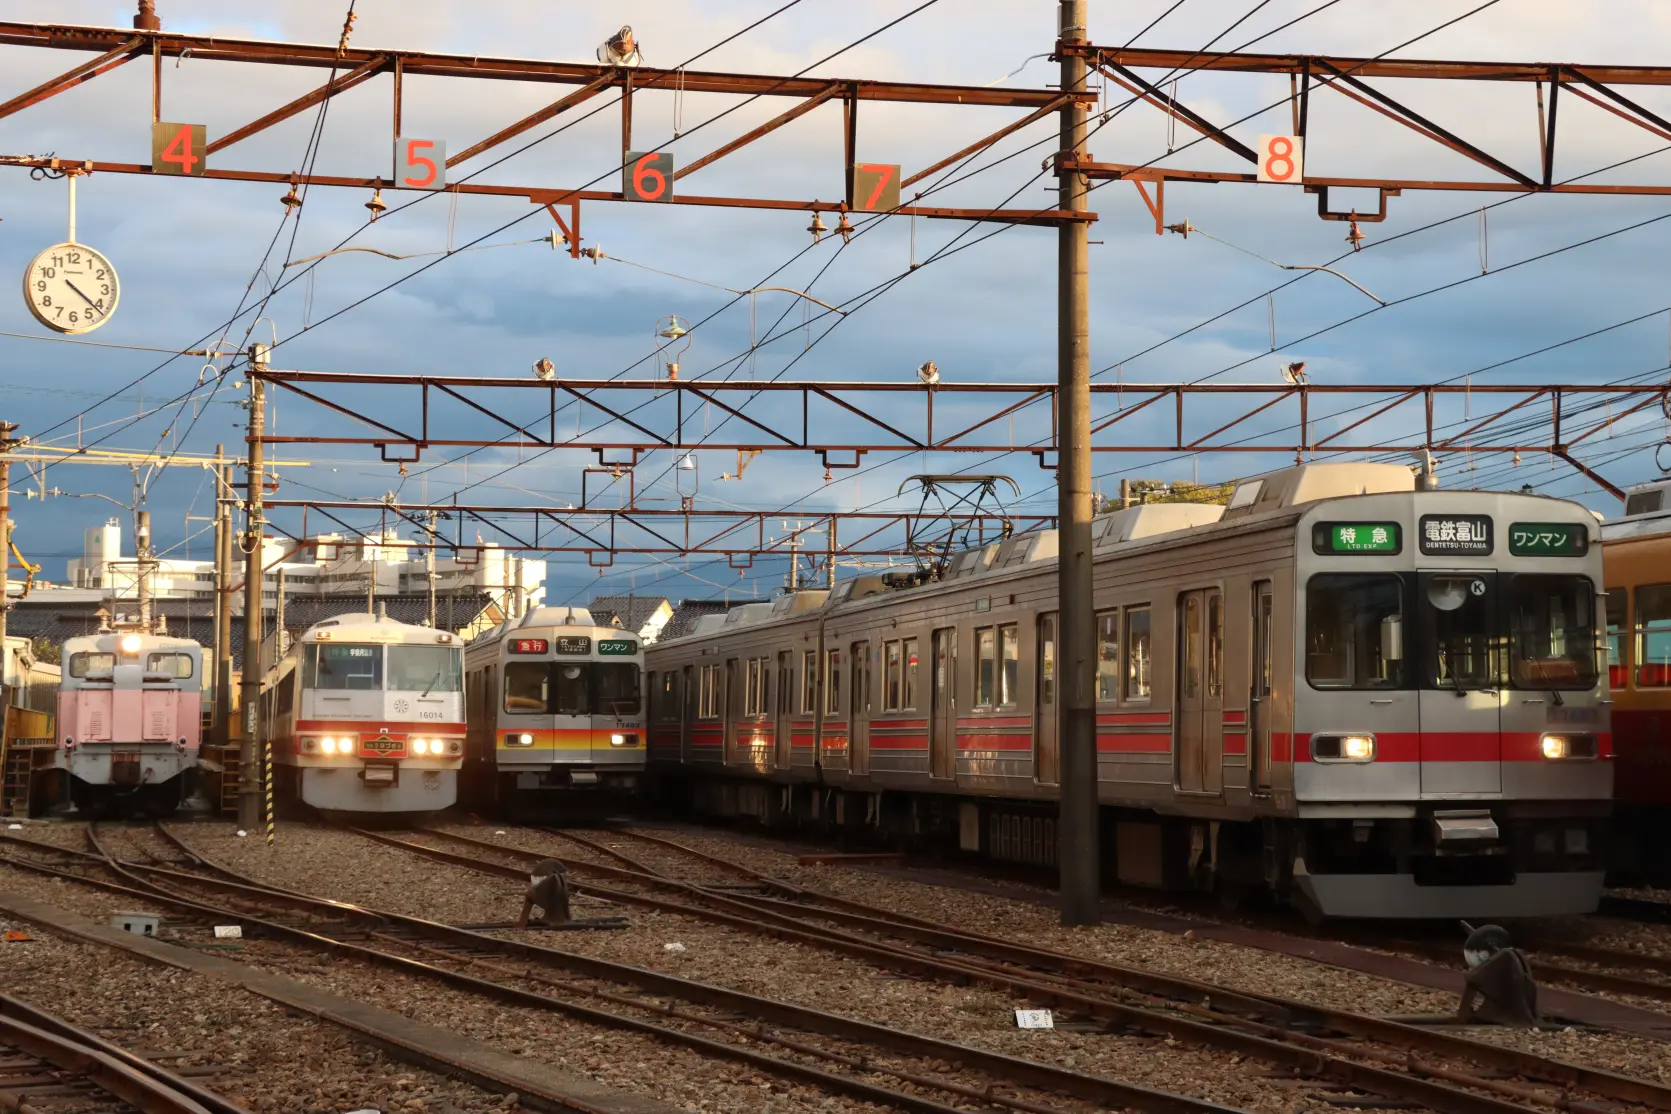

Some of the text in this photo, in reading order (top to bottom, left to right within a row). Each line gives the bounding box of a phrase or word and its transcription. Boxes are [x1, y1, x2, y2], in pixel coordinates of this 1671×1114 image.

[161, 124, 198, 174] 4
[404, 140, 437, 187] 5
[1265, 136, 1295, 182] 8
[632, 153, 666, 200] 6
[861, 164, 894, 210] 7
[51, 256, 63, 268] 11
[65, 252, 81, 265] 12
[86, 259, 93, 270] 1
[40, 267, 56, 279] 10
[96, 269, 105, 280] 2
[37, 280, 46, 292] 9
[100, 284, 109, 295] 3
[42, 295, 52, 307] 8
[94, 298, 104, 309] 4
[55, 306, 64, 318] 7
[68, 311, 78, 322] 6
[84, 308, 93, 319] 5
[1340, 527, 1388, 544] 特急
[1425, 521, 1487, 541] 電鉄富山
[1514, 532, 1567, 547] ワンマン
[1473, 582, 1483, 593] K
[521, 640, 542, 652] 急行
[560, 638, 588, 646] 立山
[600, 643, 628, 651] ワンマン
[420, 711, 443, 719] 16014
